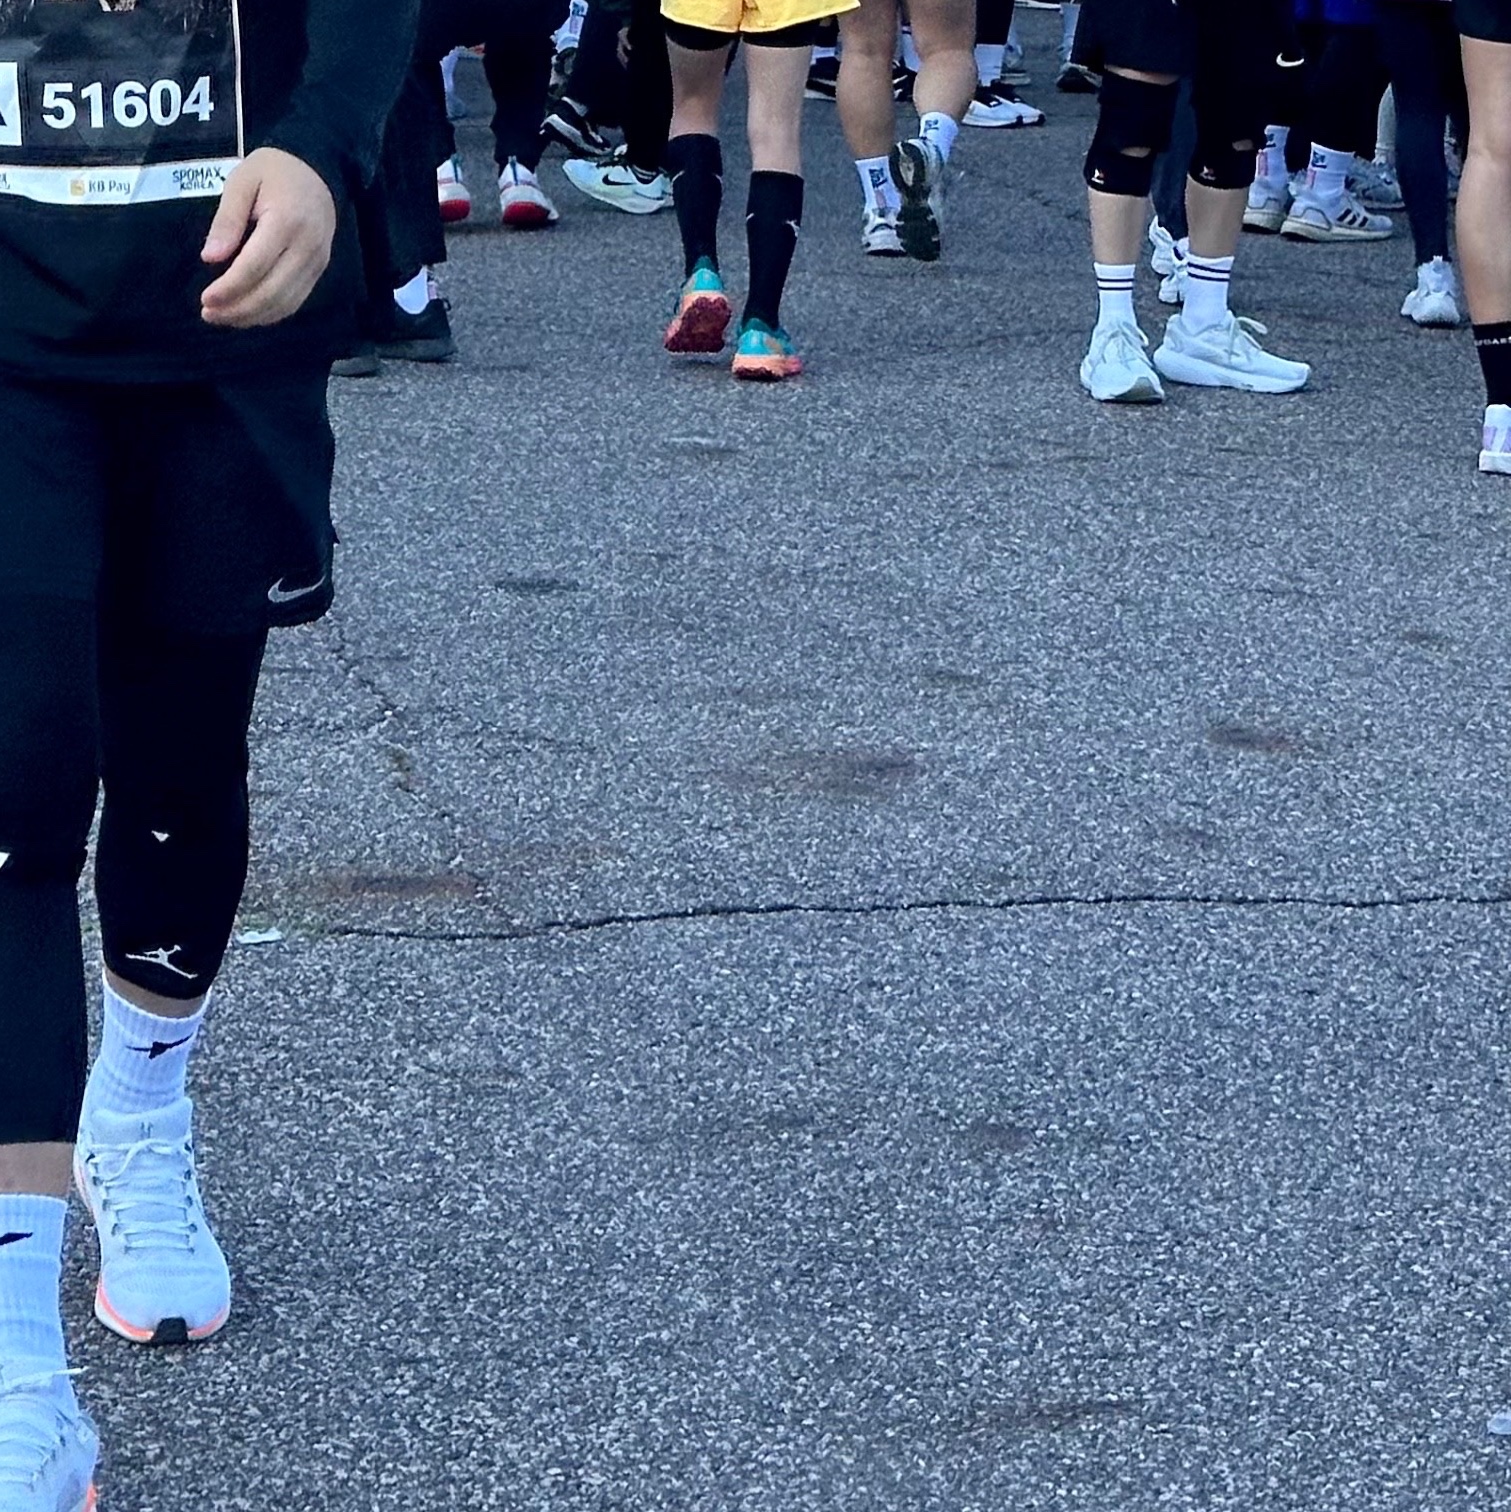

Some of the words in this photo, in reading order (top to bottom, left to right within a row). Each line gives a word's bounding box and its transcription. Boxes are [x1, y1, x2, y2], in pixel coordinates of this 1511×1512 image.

[42, 75, 215, 129] 51604
[172, 167, 222, 184] SPOMAX
[108, 180, 131, 196] Pay
